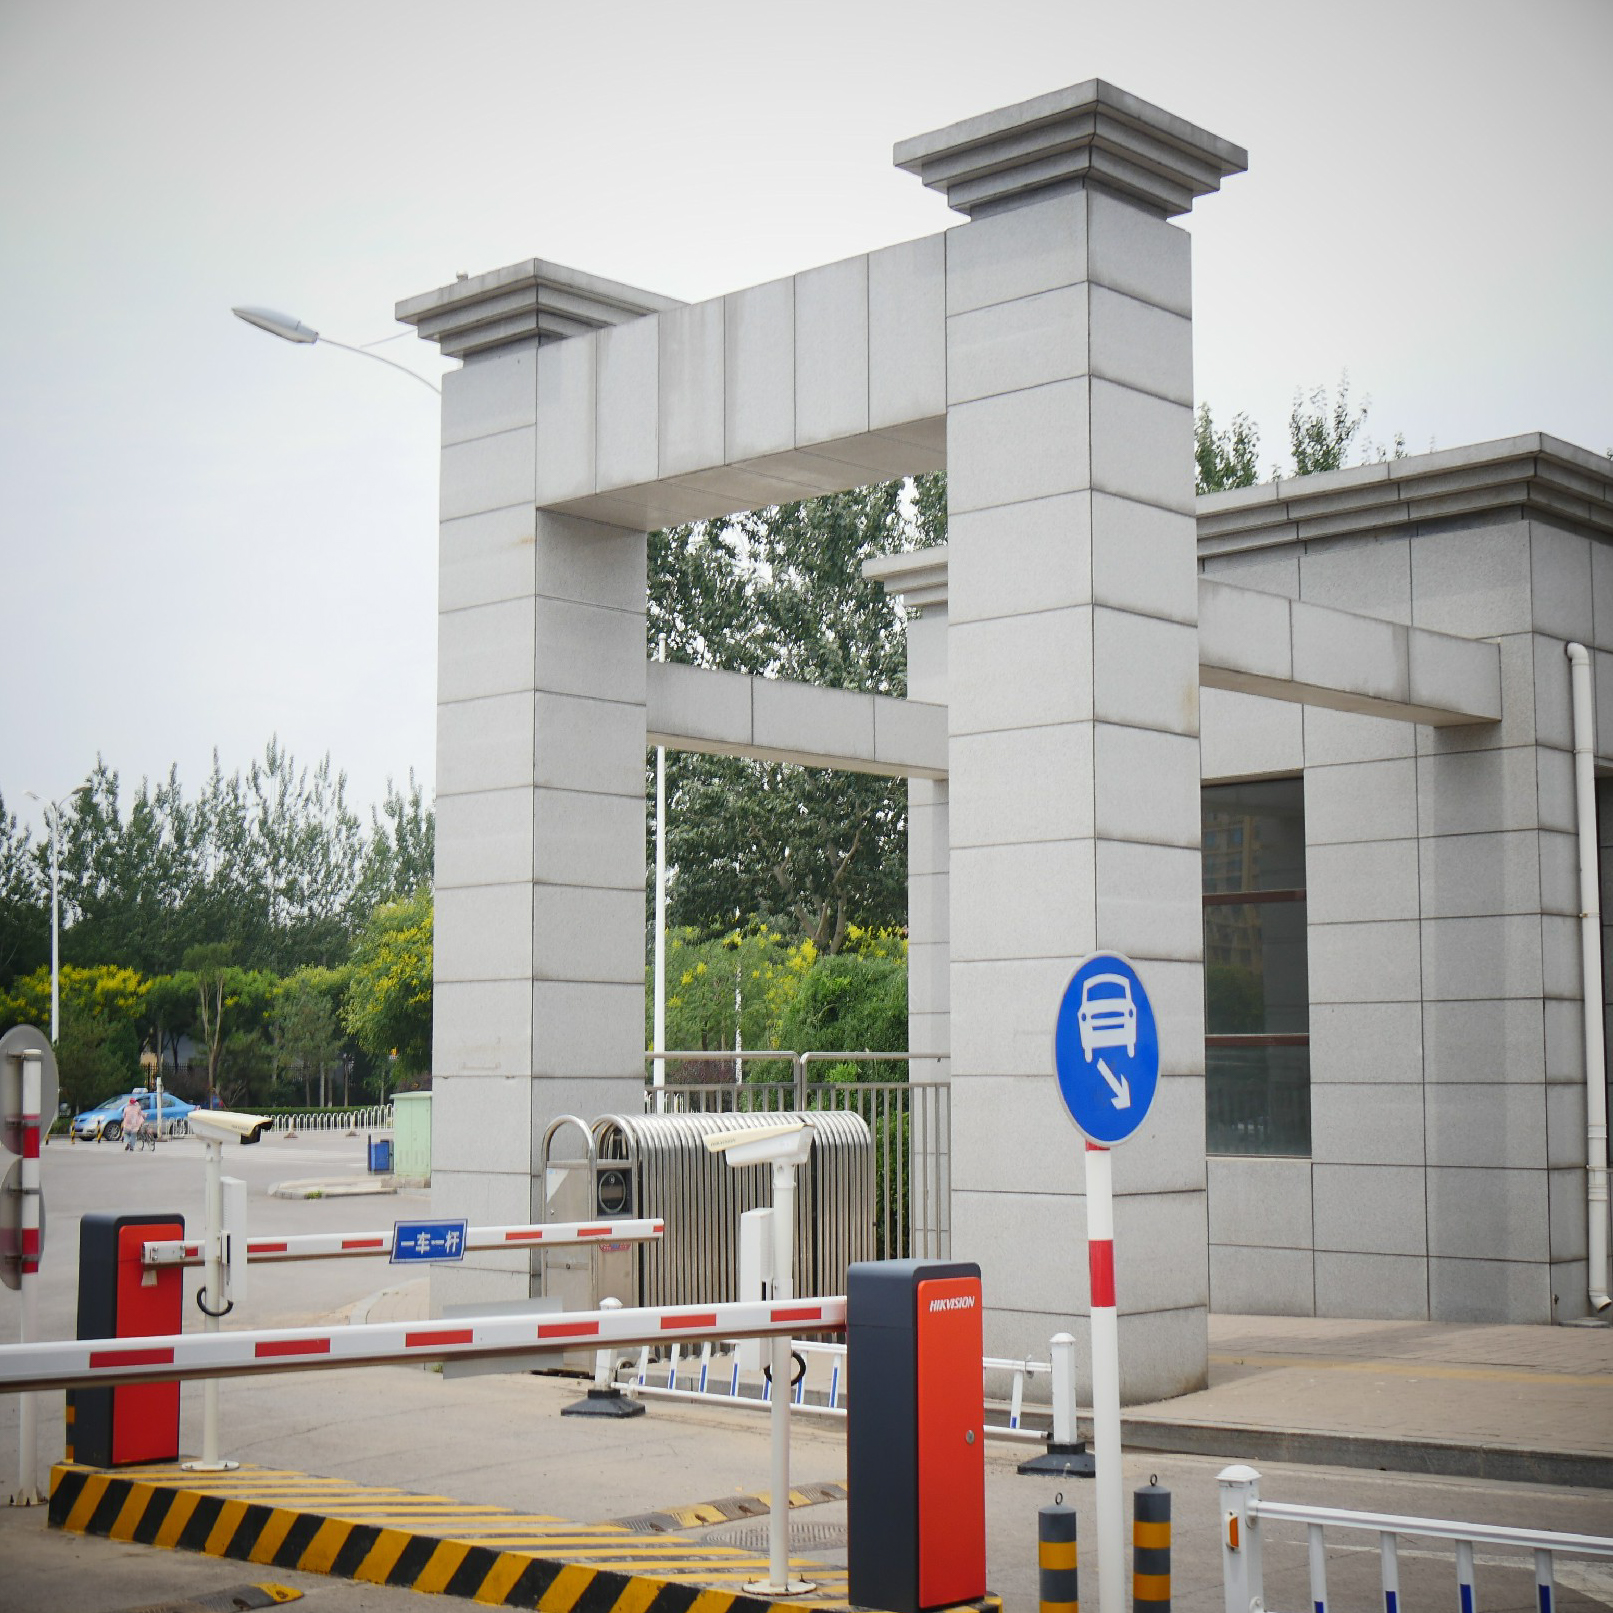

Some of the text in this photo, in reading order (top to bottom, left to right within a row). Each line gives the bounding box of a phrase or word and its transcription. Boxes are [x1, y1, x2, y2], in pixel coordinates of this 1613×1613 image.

[401, 1230, 460, 1254] 一车一杆
[929, 1296, 975, 1312] HIKVISION
